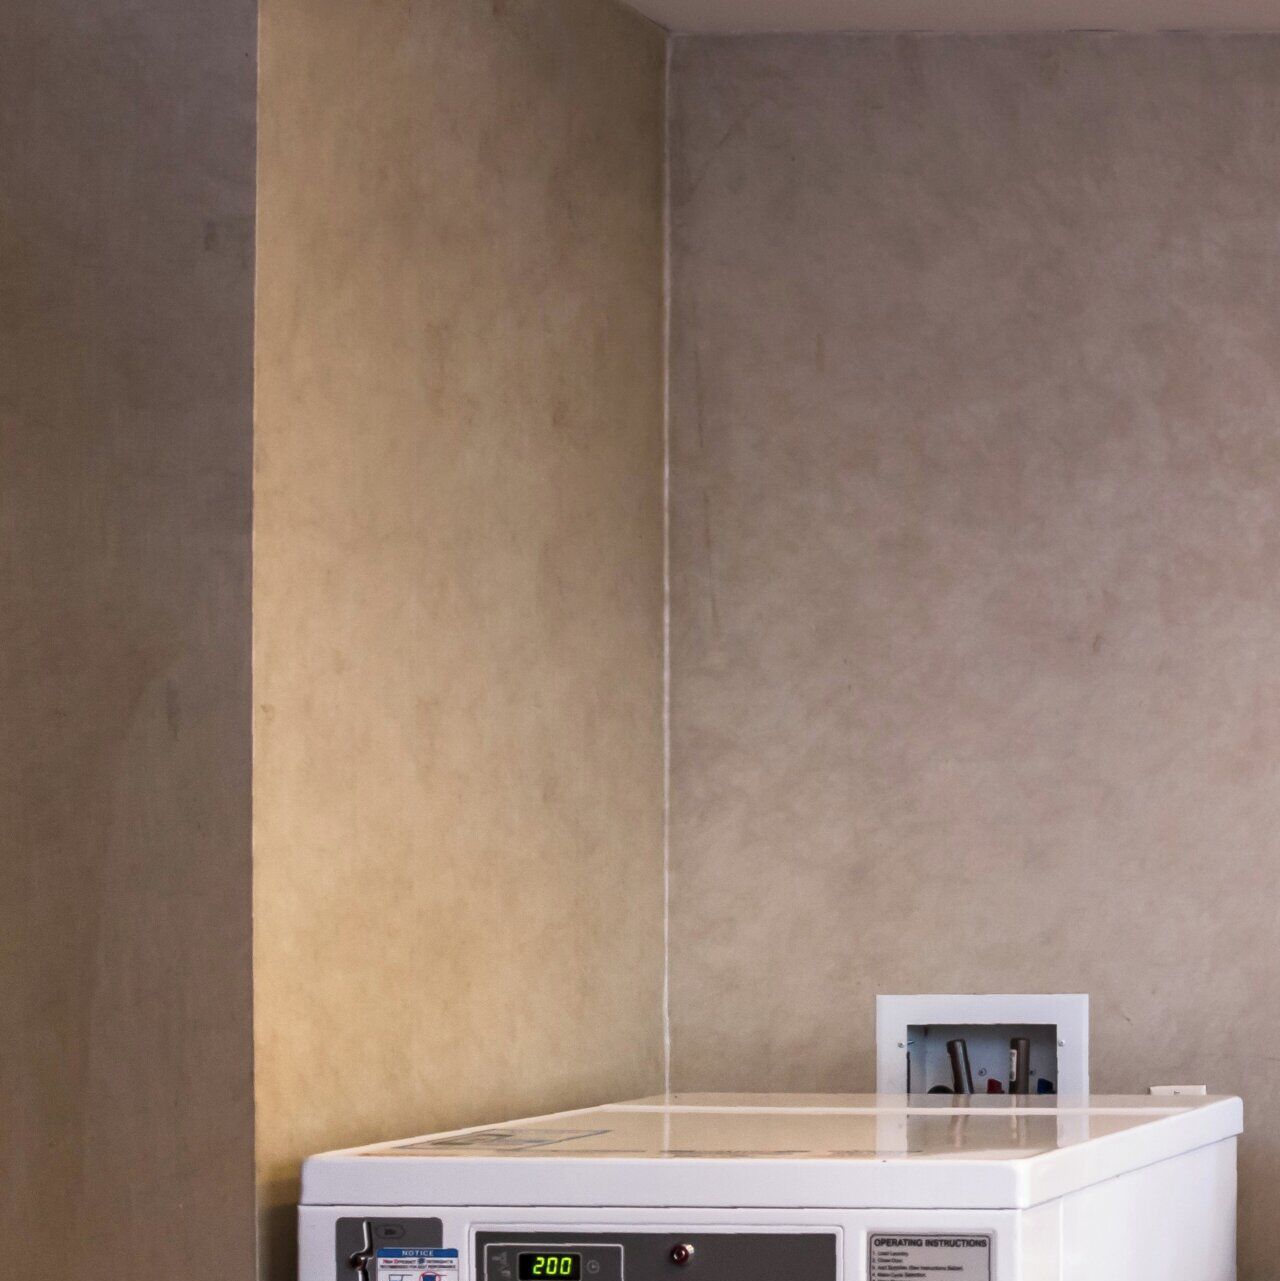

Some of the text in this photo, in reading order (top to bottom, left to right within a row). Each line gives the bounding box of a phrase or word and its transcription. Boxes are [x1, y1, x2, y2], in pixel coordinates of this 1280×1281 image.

[874, 1238, 988, 1248] OPERATING INSTRUCTIONS
[401, 1249, 434, 1257] NOTICE
[532, 1257, 572, 1275] 200
